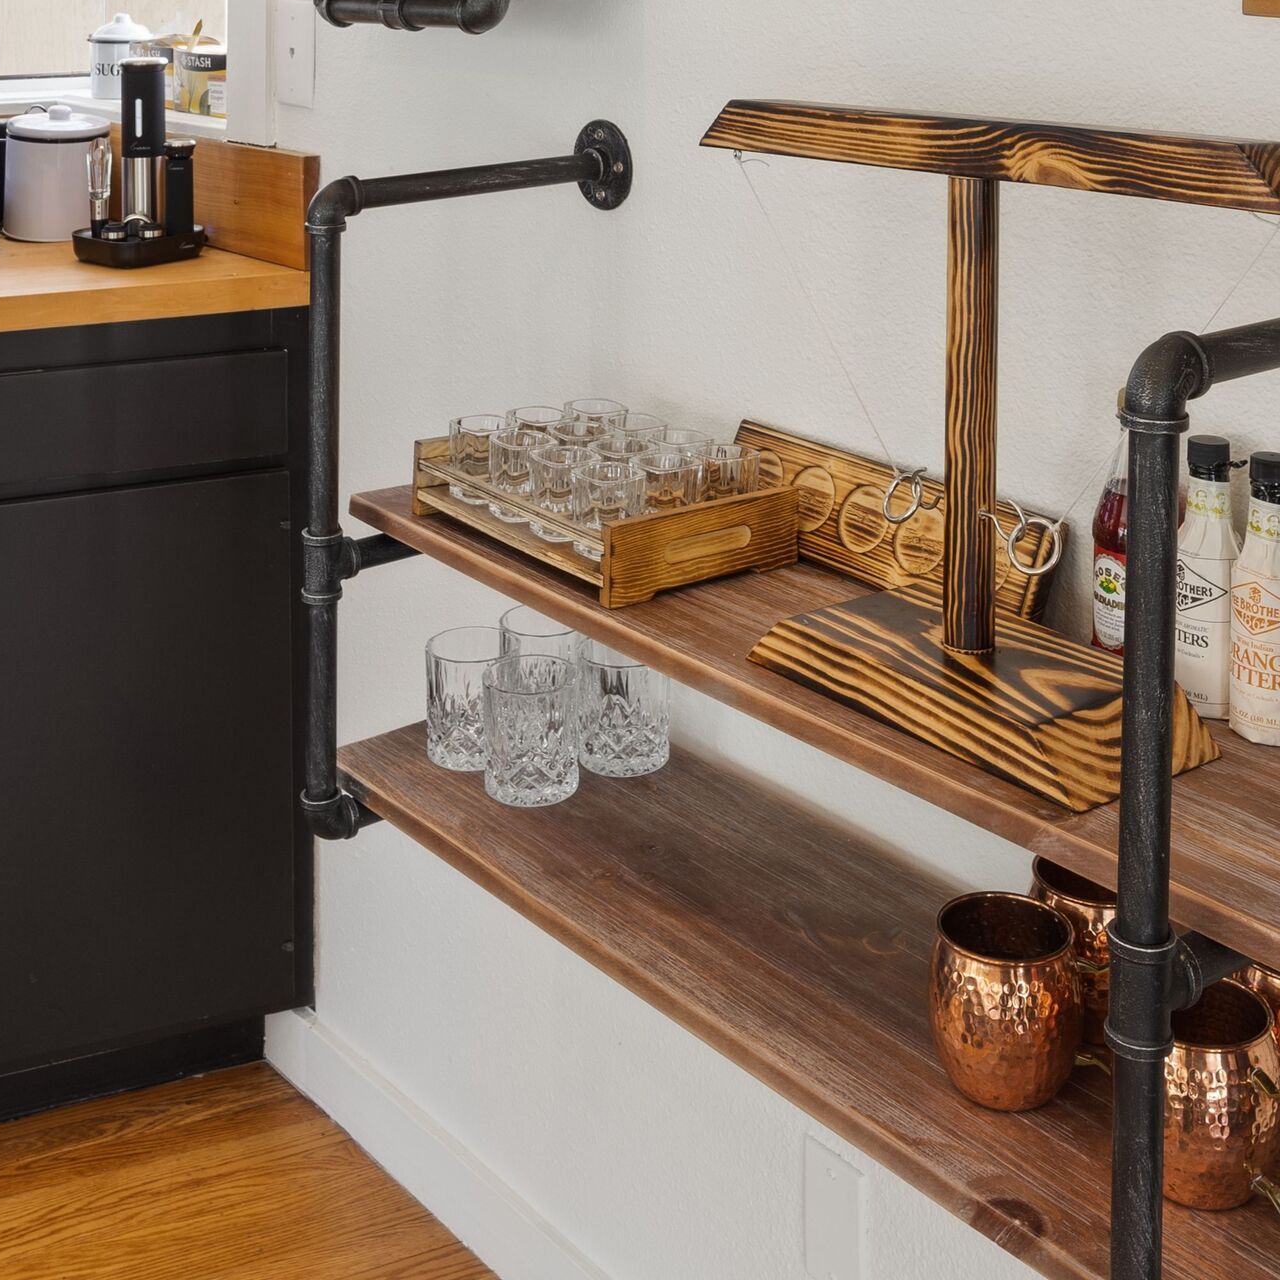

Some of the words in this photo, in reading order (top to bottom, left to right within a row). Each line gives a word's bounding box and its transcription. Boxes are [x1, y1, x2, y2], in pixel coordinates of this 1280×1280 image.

[187, 56, 212, 68] STASH
[95, 63, 120, 77] SUG
[1176, 628, 1209, 648] TERS
